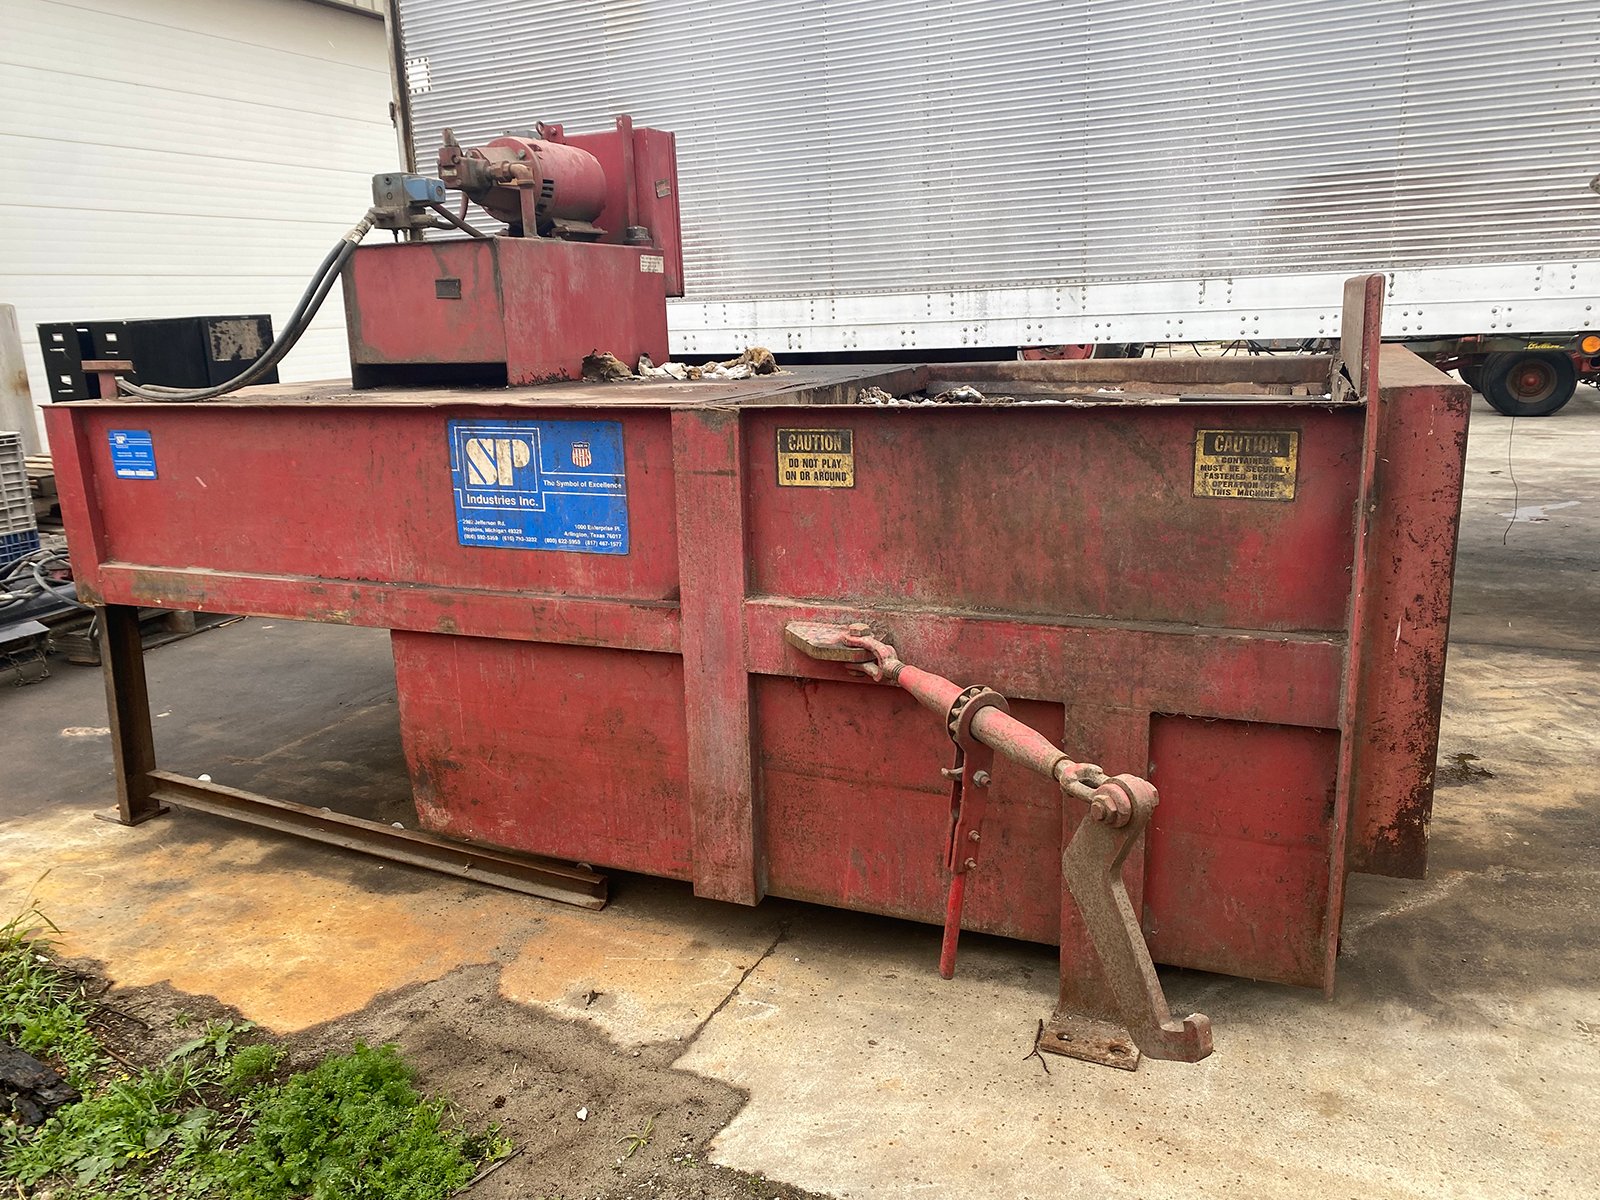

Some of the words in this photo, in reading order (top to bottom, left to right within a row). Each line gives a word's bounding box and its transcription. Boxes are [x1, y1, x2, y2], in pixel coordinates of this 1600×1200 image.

[788, 434, 842, 451] CAUTION
[1214, 434, 1280, 453] CAUTION
[465, 438, 530, 486] SP
[788, 458, 800, 468] DO
[803, 458, 818, 469] NOT
[822, 459, 842, 469] PLAY
[1221, 456, 1270, 465] CONTAINER
[1200, 464, 1225, 473] MUST
[1229, 465, 1240, 473] BE
[1246, 465, 1291, 474] SECURELY
[785, 470, 797, 481] ON
[800, 470, 811, 481] OR
[813, 471, 847, 482] AROUND
[1204, 473, 1246, 481] FASTENED
[543, 479, 555, 487] The
[556, 480, 579, 488] Symbol
[588, 481, 622, 489] Excellence
[1211, 481, 1258, 489] OPERATION
[1212, 488, 1232, 497] THIS
[1237, 489, 1276, 498] MACHINE
[466, 493, 516, 506] Industries
[519, 495, 539, 507] Inc.
[484, 527, 508, 535] Michigan
[587, 524, 613, 532] Enterprise
